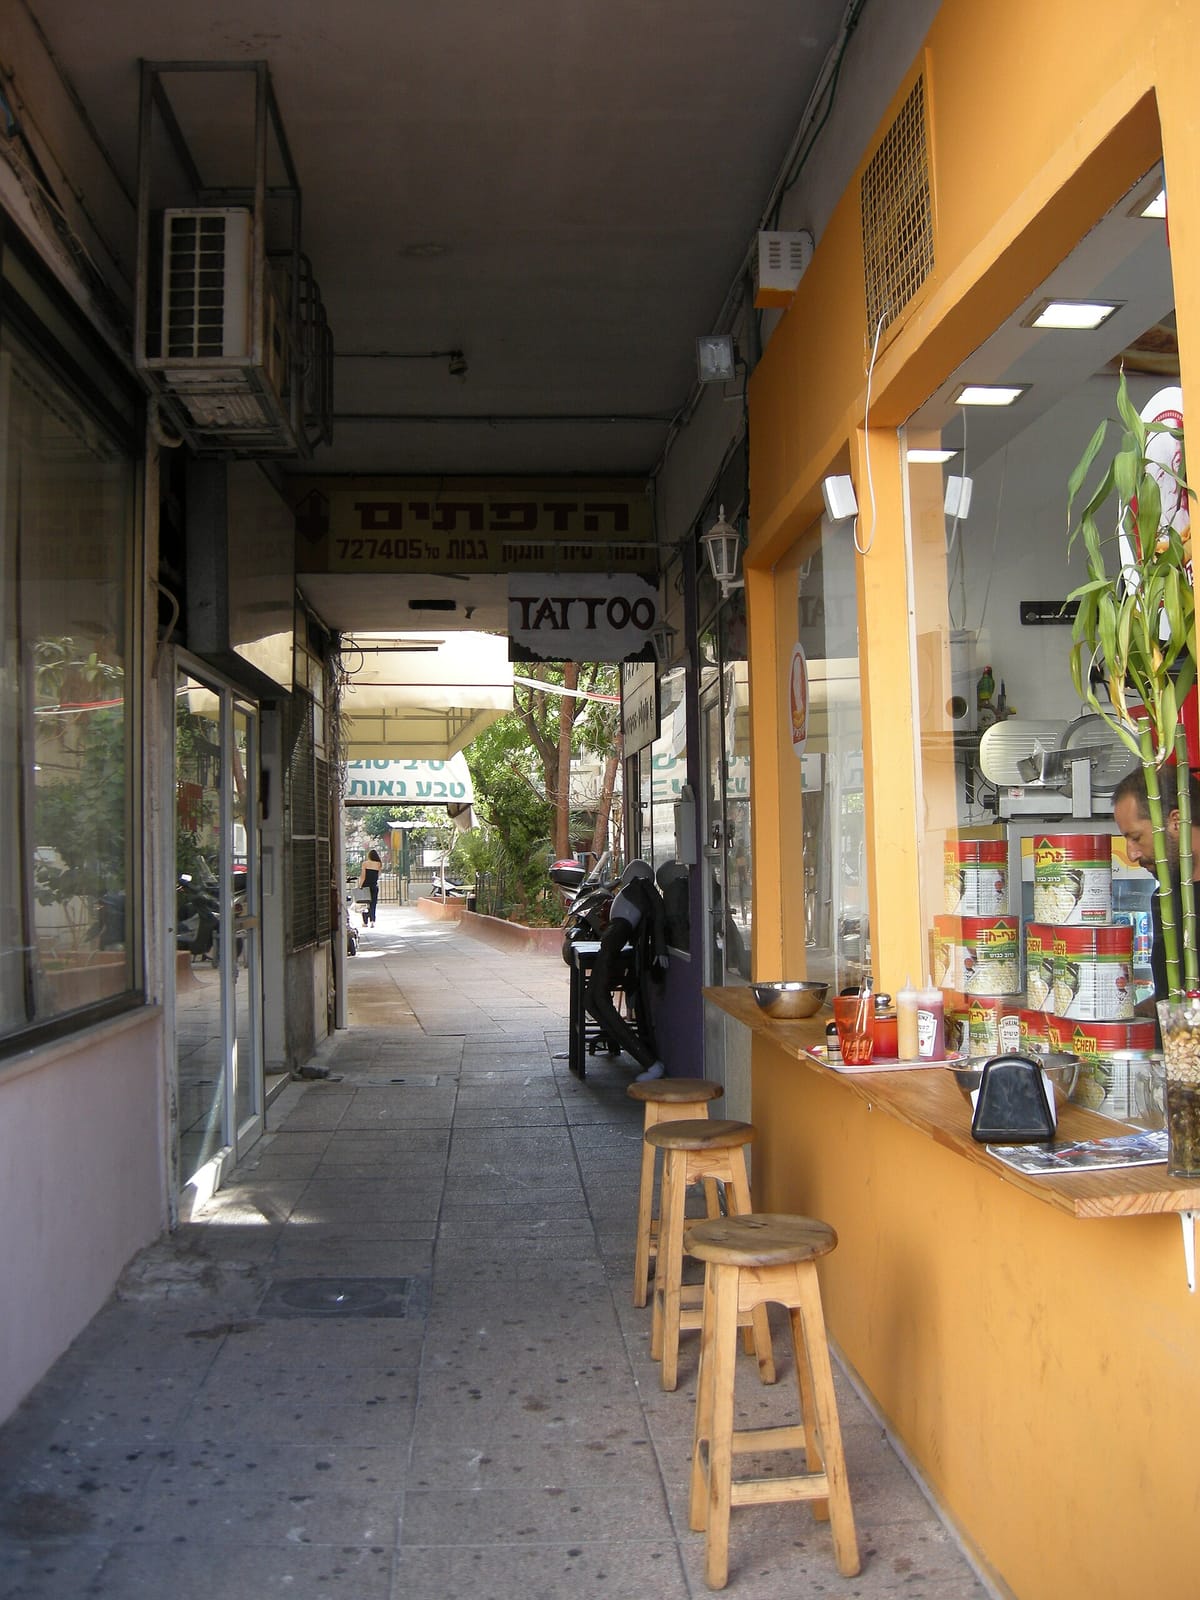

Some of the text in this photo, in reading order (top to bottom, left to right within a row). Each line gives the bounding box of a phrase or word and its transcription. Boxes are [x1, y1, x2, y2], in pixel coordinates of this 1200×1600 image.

[335, 539, 422, 560] 727405
[446, 539, 489, 560] גגות
[508, 596, 656, 631] TATTOO
[348, 779, 466, 799] טבע נאות
